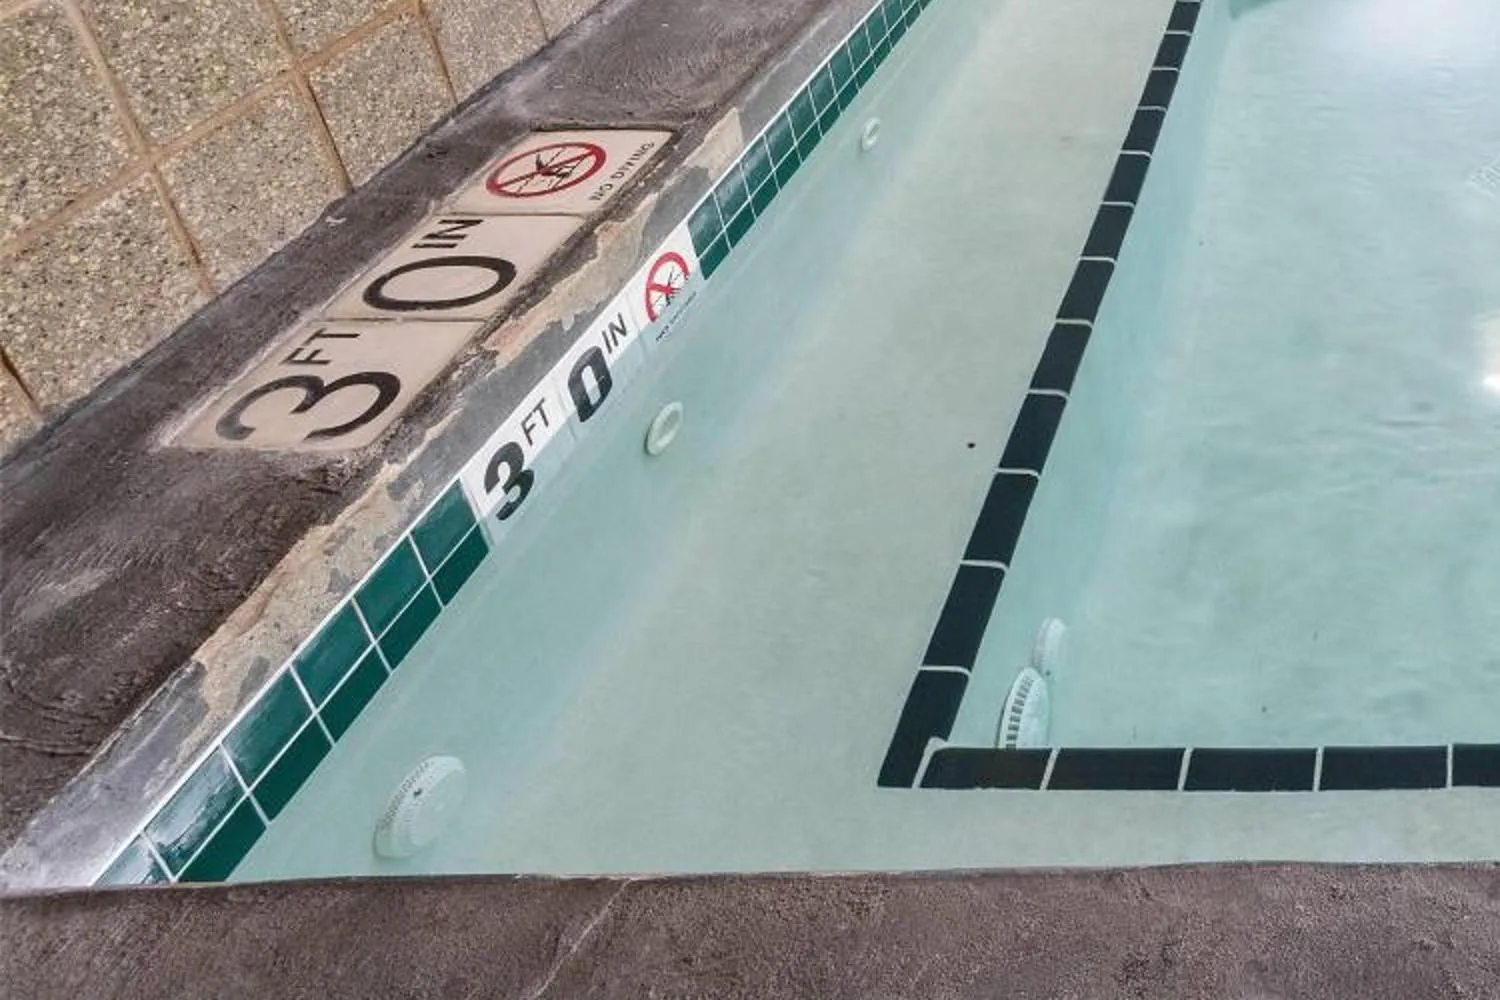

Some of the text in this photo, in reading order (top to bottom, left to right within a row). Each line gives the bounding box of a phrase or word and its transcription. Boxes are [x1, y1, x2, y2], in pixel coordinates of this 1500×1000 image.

[588, 142, 655, 201] NO DIVING
[215, 219, 517, 441] 3 FT 0 IN
[484, 312, 628, 521] 3 FT 0 IN
